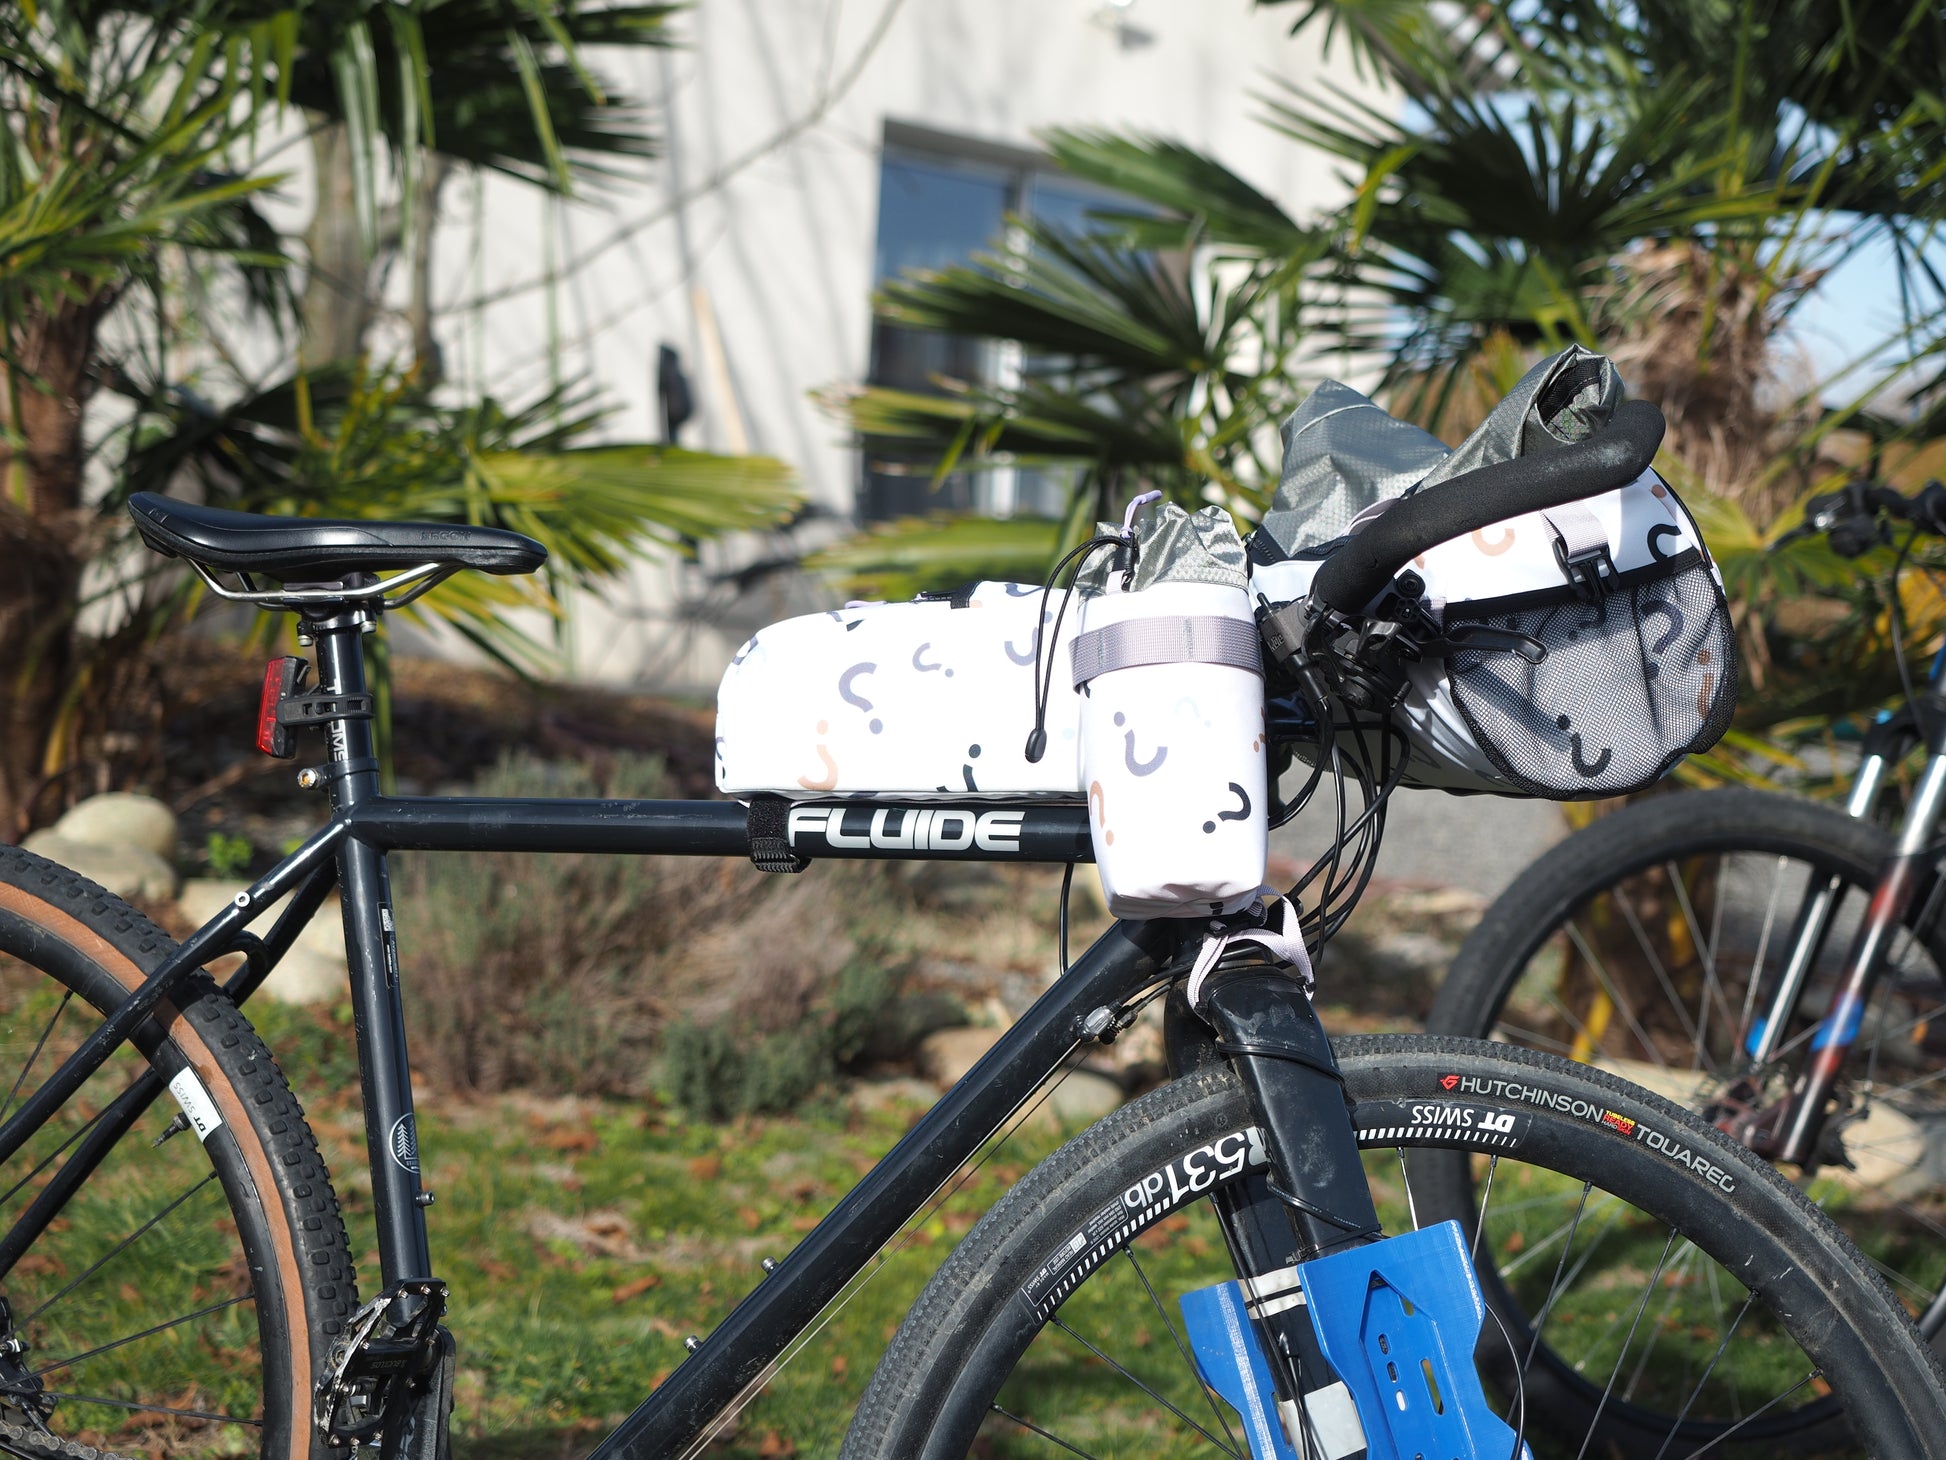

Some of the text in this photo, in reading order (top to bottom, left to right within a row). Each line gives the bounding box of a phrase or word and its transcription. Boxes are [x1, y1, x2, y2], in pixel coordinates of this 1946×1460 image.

[787, 807, 1026, 852] FLUIDE
[174, 1082, 207, 1133] DT SWISS
[1411, 1105, 1516, 1133] DT SWISS
[1460, 1076, 1604, 1123] HUTCHINSON
[1603, 1113, 1634, 1131] READY
[1606, 1110, 1636, 1126] TUBELESS
[1636, 1123, 1736, 1193] TOUAREG
